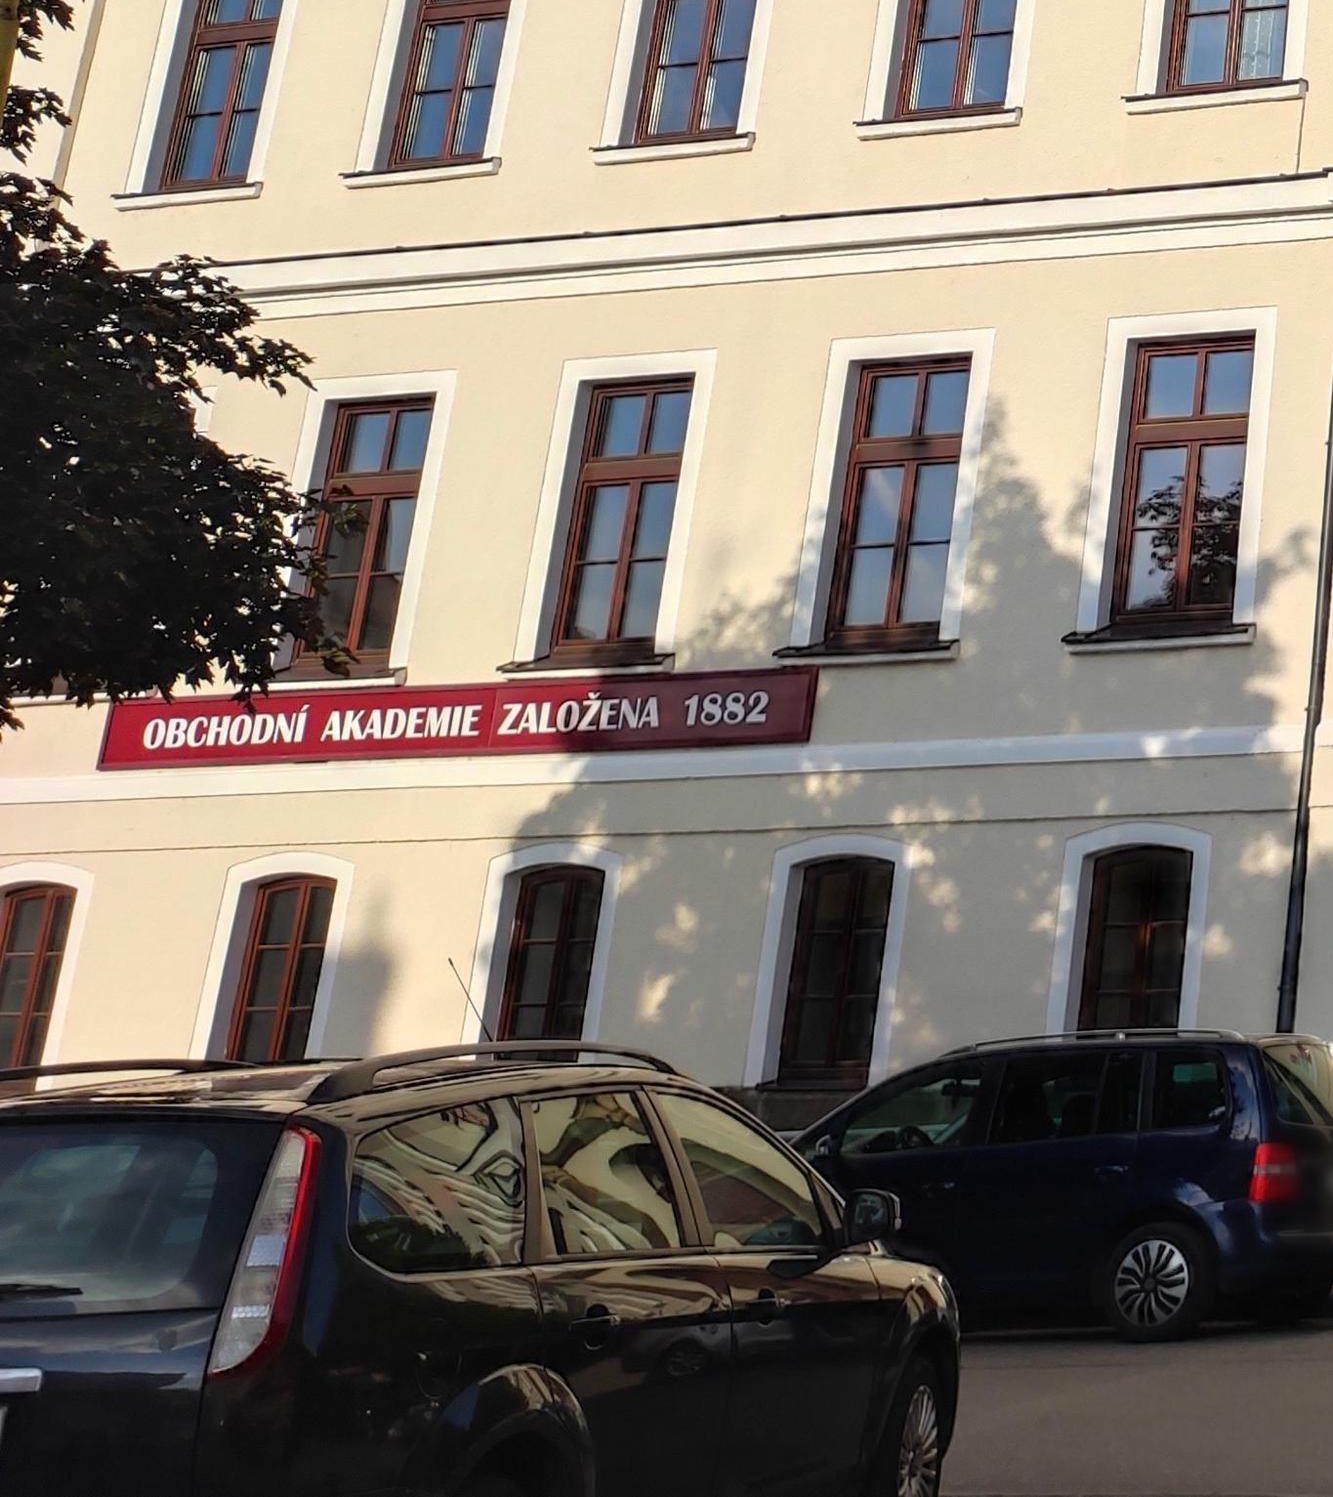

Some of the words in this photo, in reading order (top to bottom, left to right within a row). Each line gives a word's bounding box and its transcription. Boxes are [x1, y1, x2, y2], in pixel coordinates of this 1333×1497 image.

[143, 704, 310, 749] OBCHODNÍ
[320, 704, 483, 742] AKADEMIE
[497, 692, 659, 735] ZALOŽENA
[684, 691, 769, 726] 1882
